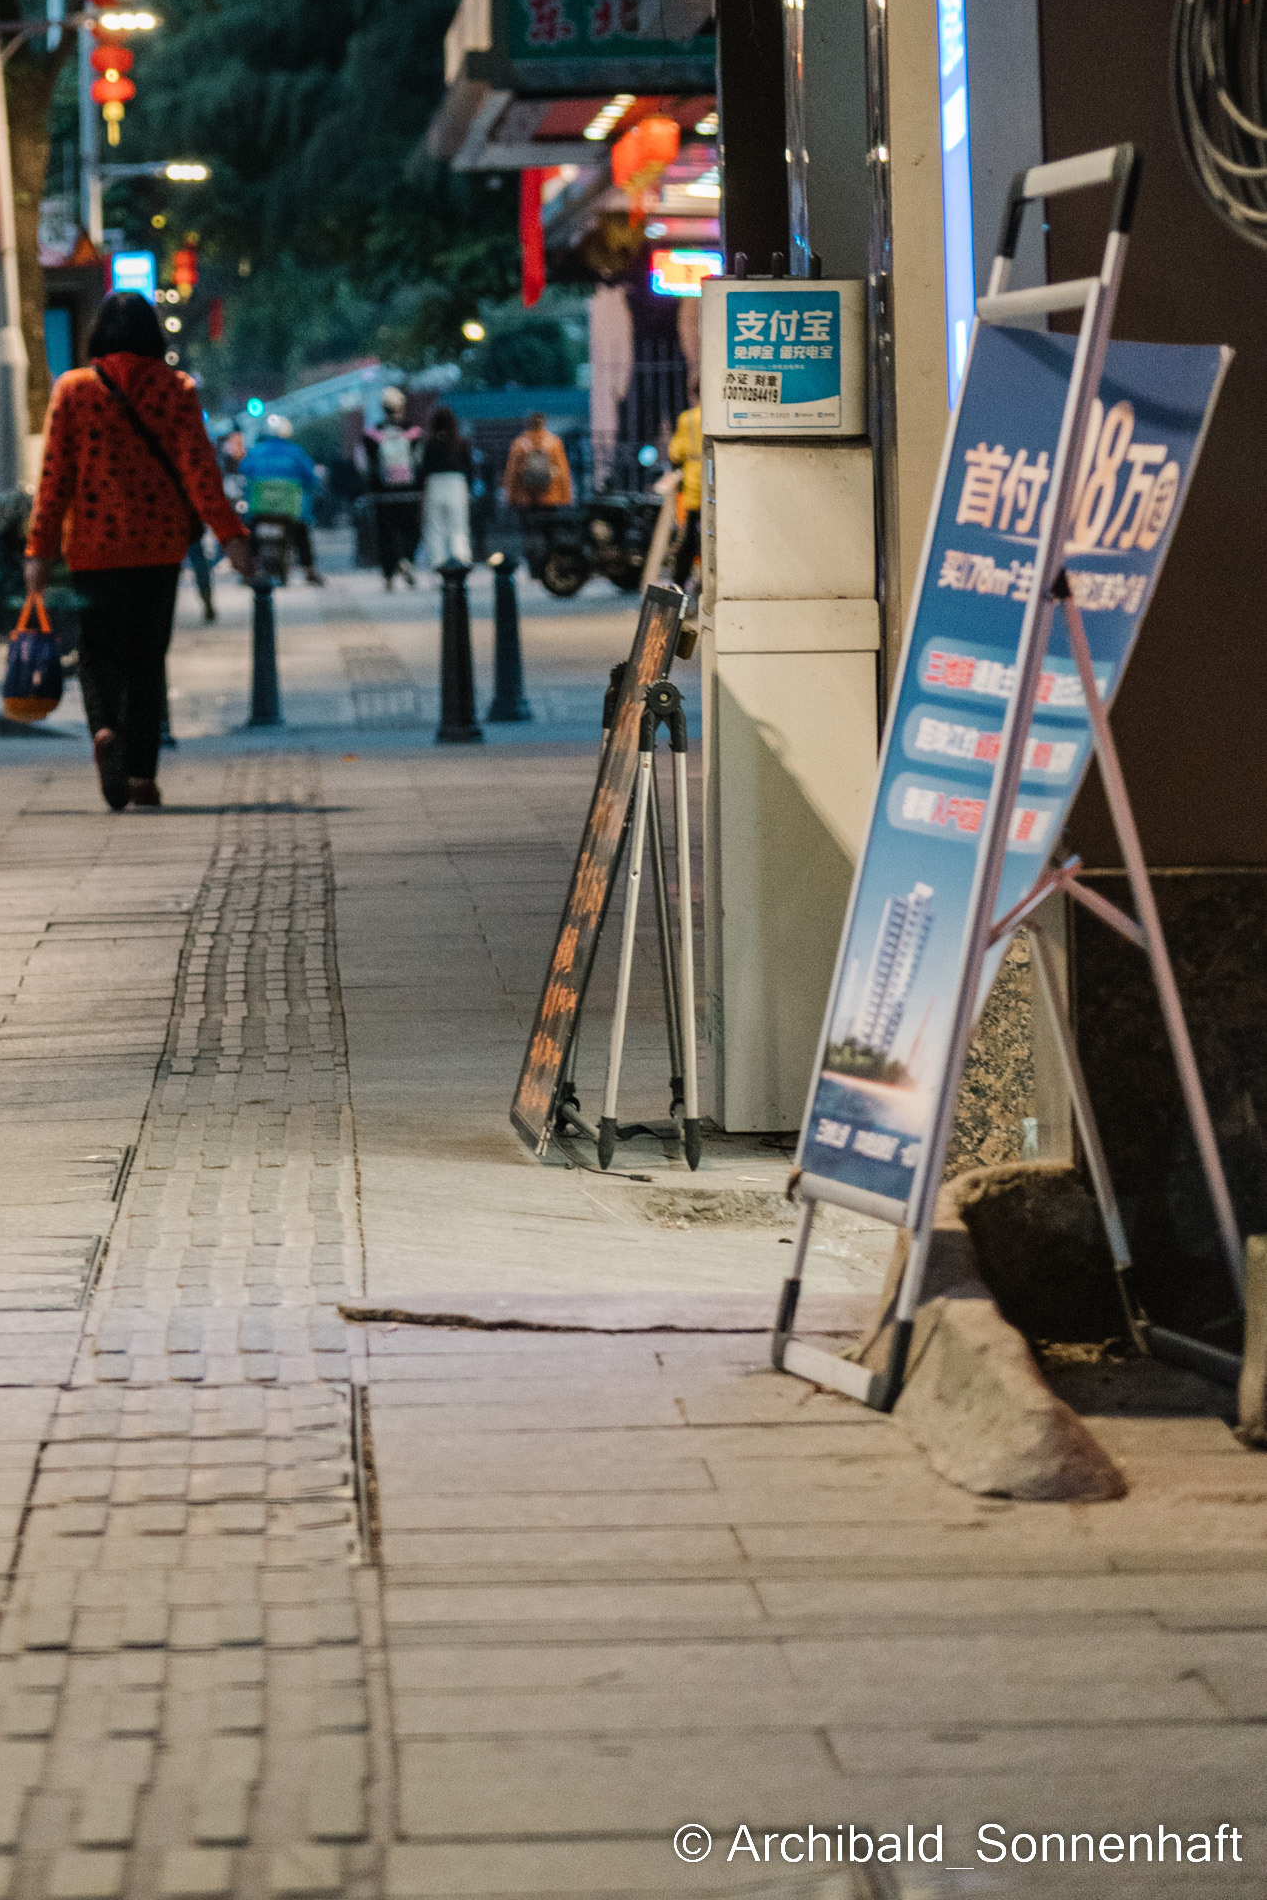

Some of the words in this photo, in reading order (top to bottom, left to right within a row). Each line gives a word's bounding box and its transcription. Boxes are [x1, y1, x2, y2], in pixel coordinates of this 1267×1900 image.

[734, 309, 833, 342] 支付宝
[734, 345, 774, 360] 免押金
[725, 372, 749, 385] 办证
[754, 373, 778, 387] 刻章
